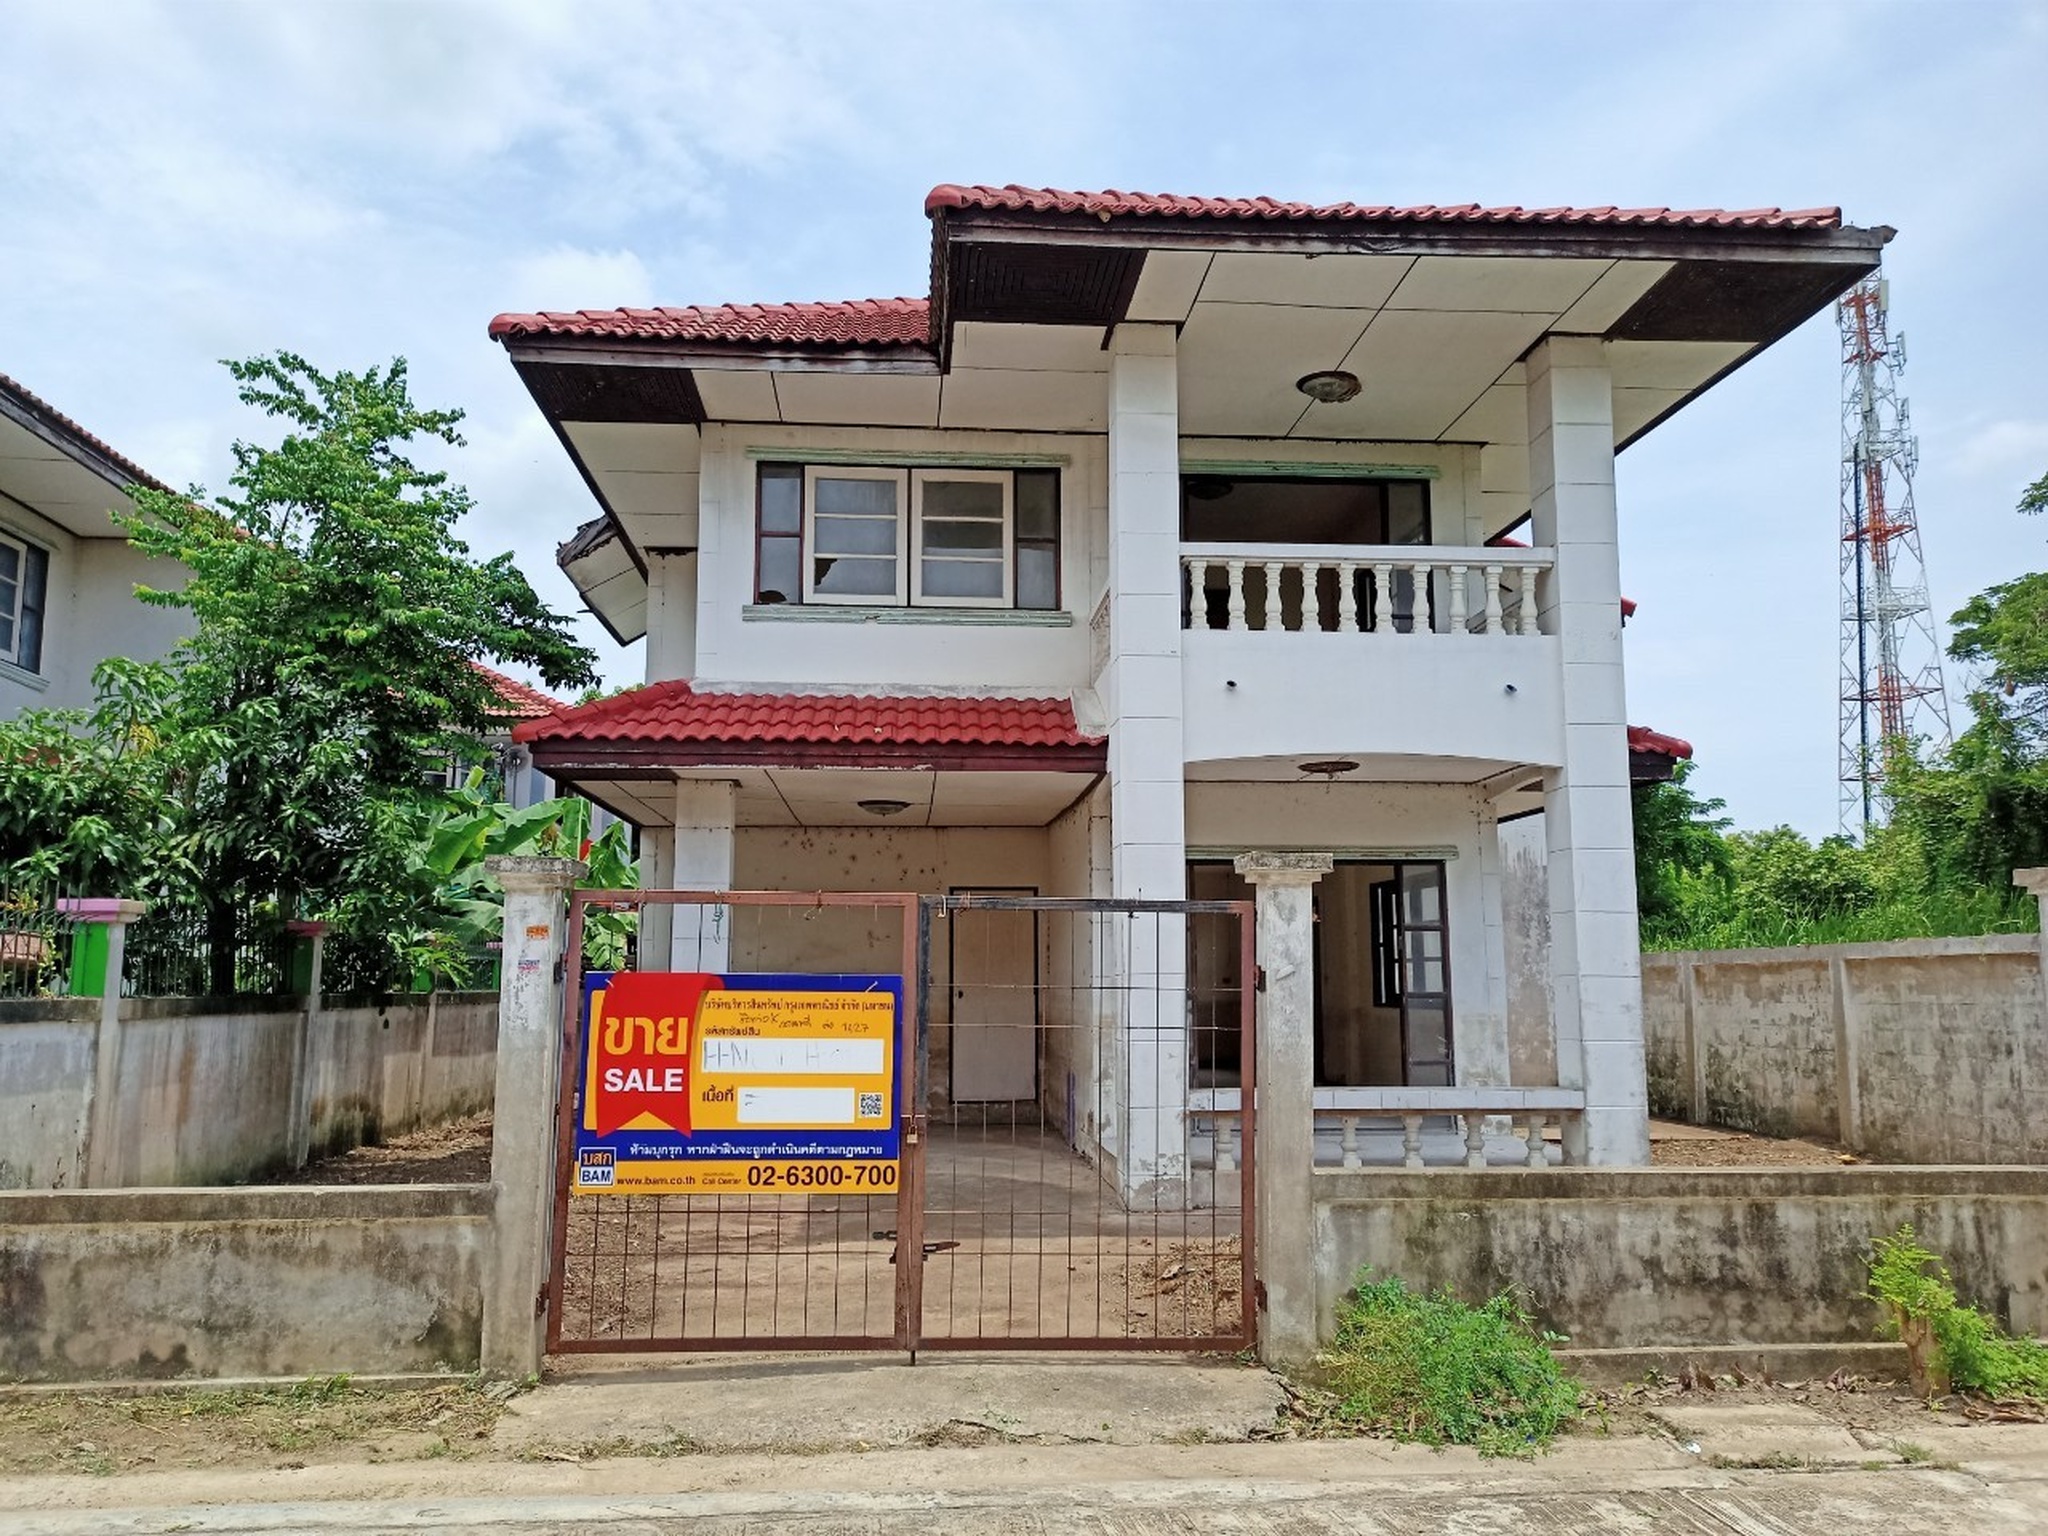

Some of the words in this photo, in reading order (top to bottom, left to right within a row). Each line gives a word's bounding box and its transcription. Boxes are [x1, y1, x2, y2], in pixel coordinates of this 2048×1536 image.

[604, 1016, 687, 1056] ขาย
[604, 1068, 684, 1093] SALE
[702, 1085, 734, 1102] เนื้อที่
[583, 1152, 612, 1165] บสก
[582, 1168, 611, 1183] BAM
[617, 1175, 696, 1186] www.bam.co.th
[747, 1165, 896, 1186] 02-6300-700
